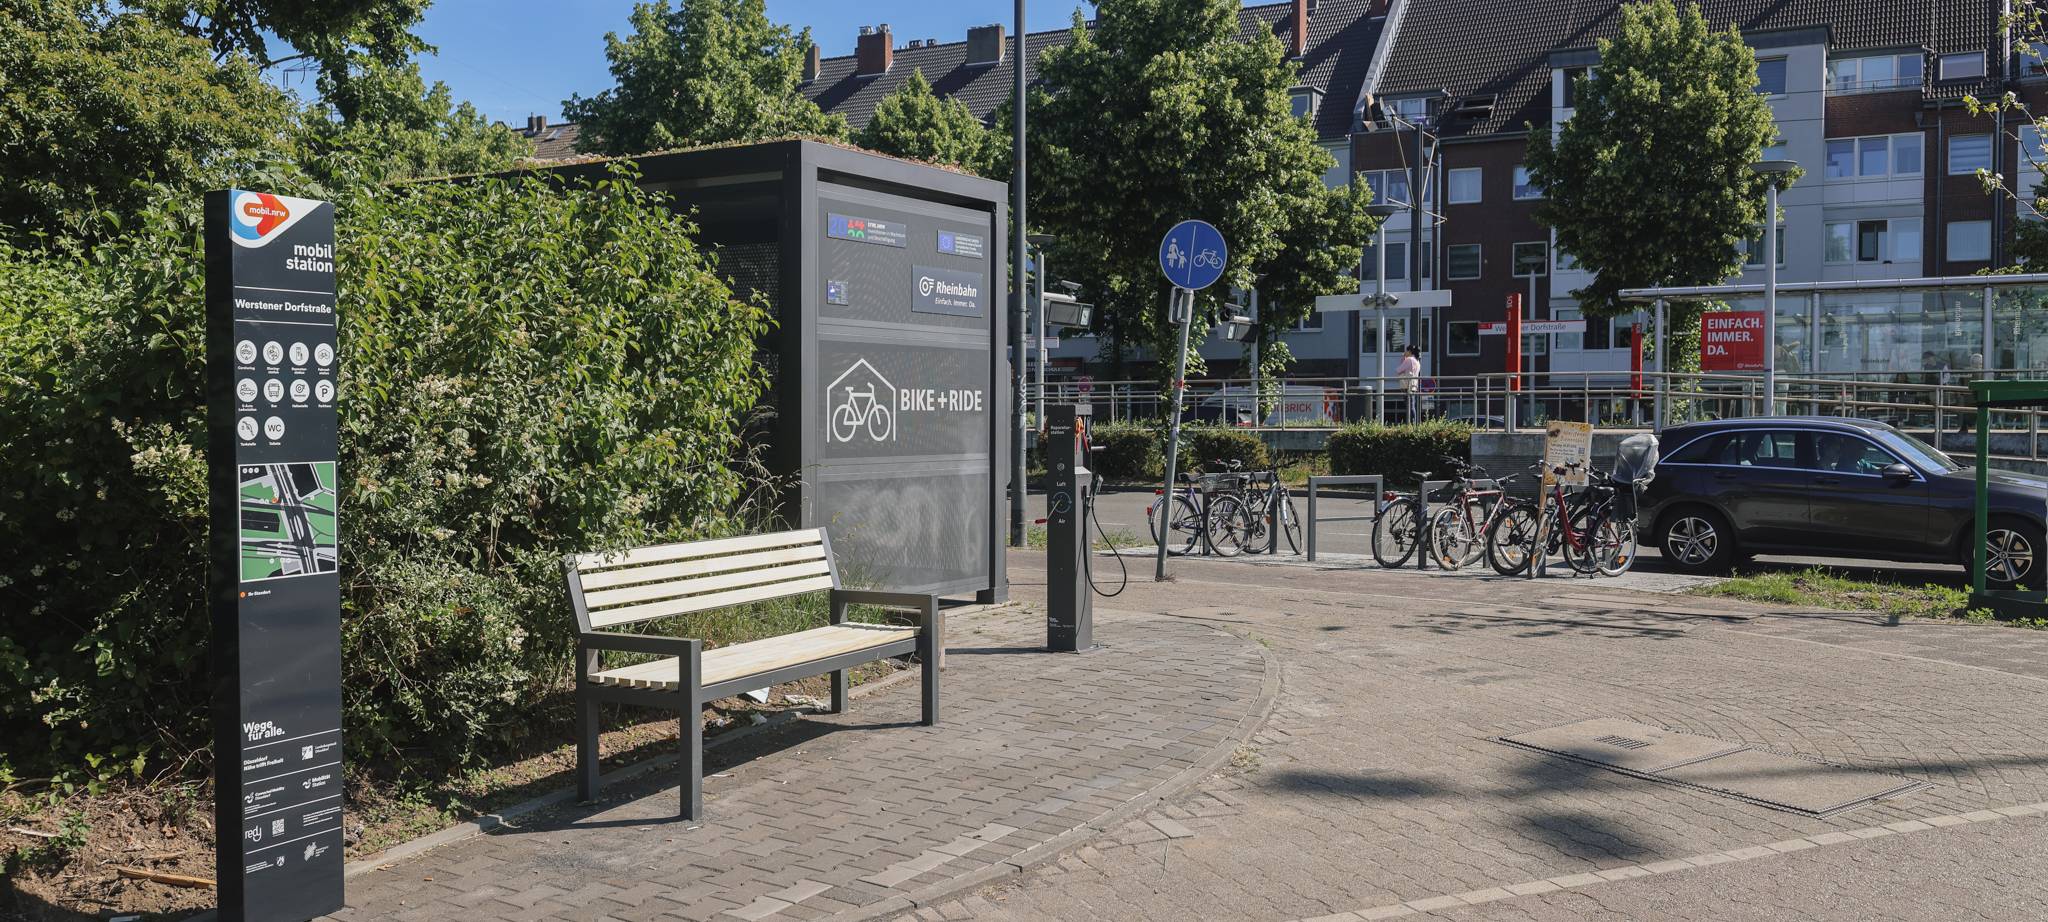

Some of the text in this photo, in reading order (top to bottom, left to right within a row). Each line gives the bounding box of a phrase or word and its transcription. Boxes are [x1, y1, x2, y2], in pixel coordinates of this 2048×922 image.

[249, 206, 286, 217] mobil.nrw
[294, 243, 333, 259] mobil
[286, 257, 333, 273] station
[936, 281, 977, 298] Rheinbahn
[235, 299, 332, 314] Werstener Dorfstraße
[935, 297, 952, 306] Einfach.
[1707, 318, 1764, 330] EINFACH.
[1707, 331, 1754, 342] IMMER.
[1707, 345, 1729, 356] DA.
[900, 388, 935, 412] BIKE
[949, 389, 983, 412] RIDE
[268, 424, 282, 432] WC
[243, 721, 273, 734] Wege
[248, 726, 286, 742] für alle.
[244, 825, 262, 842] redy
